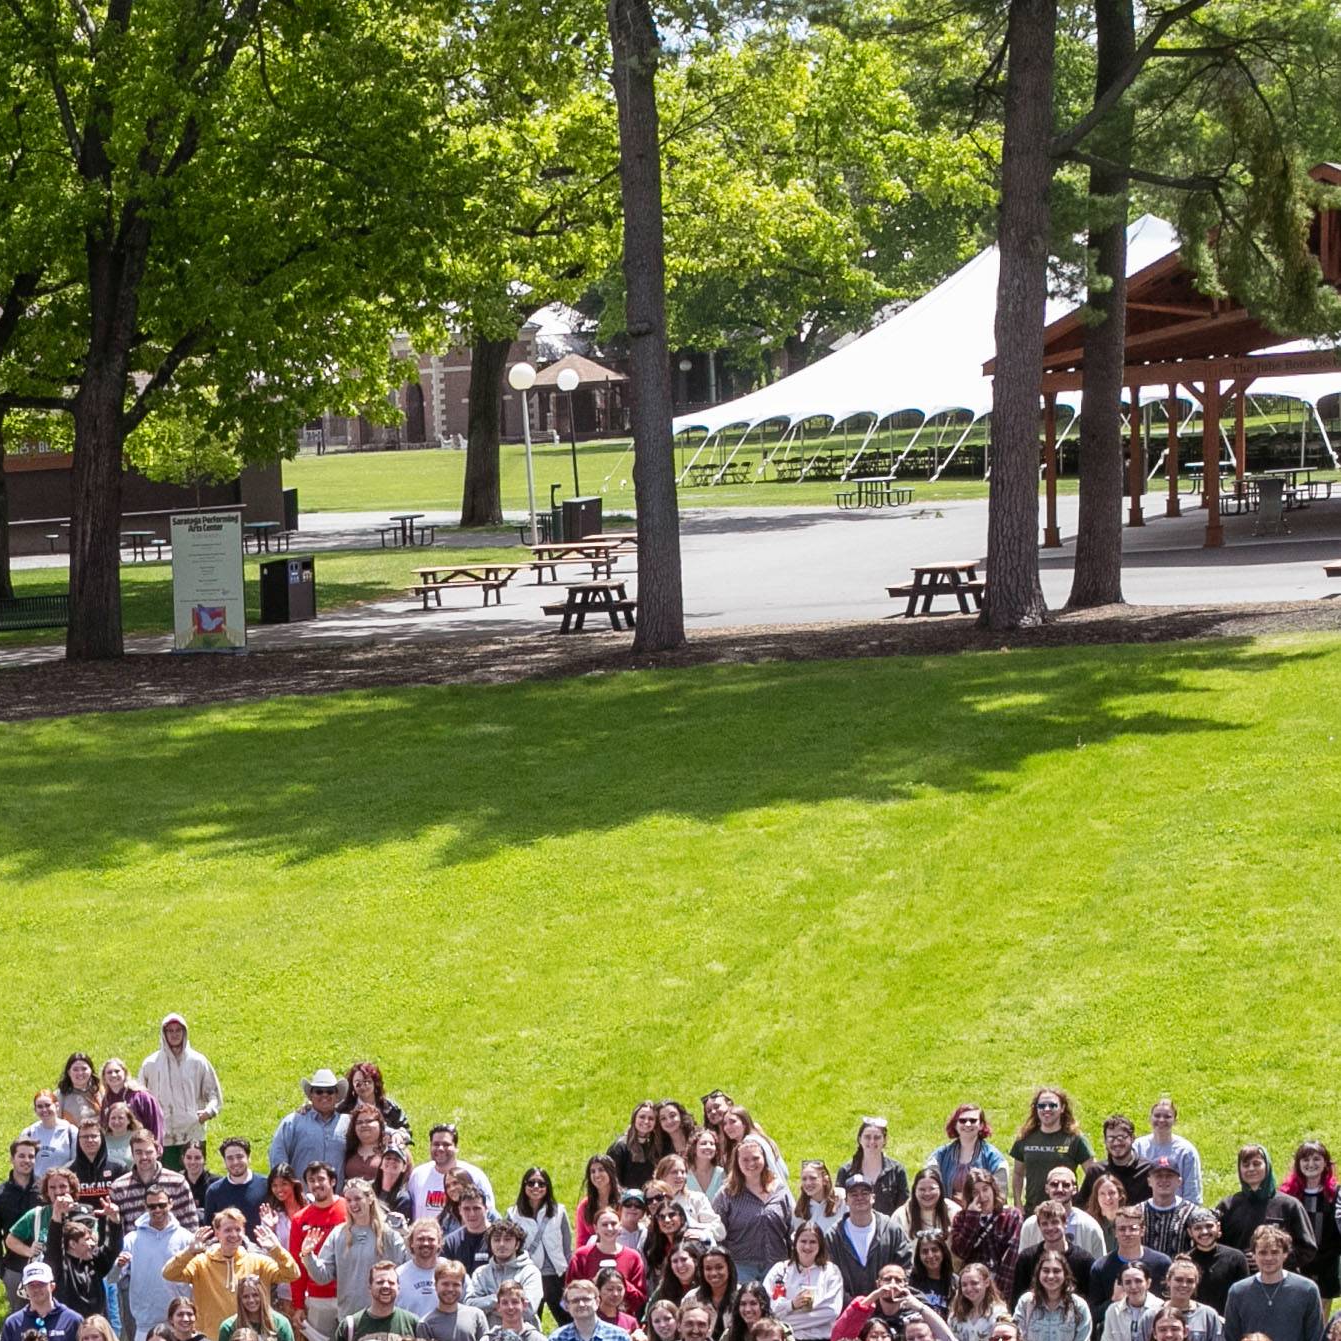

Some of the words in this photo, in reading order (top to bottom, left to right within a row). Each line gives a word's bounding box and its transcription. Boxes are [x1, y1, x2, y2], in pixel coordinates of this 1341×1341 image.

[172, 516, 201, 526] Saratoga
[202, 515, 238, 525] Performing
[188, 524, 202, 532] Arts
[203, 523, 223, 532] Center
[79, 1180, 112, 1189] ENGALS
